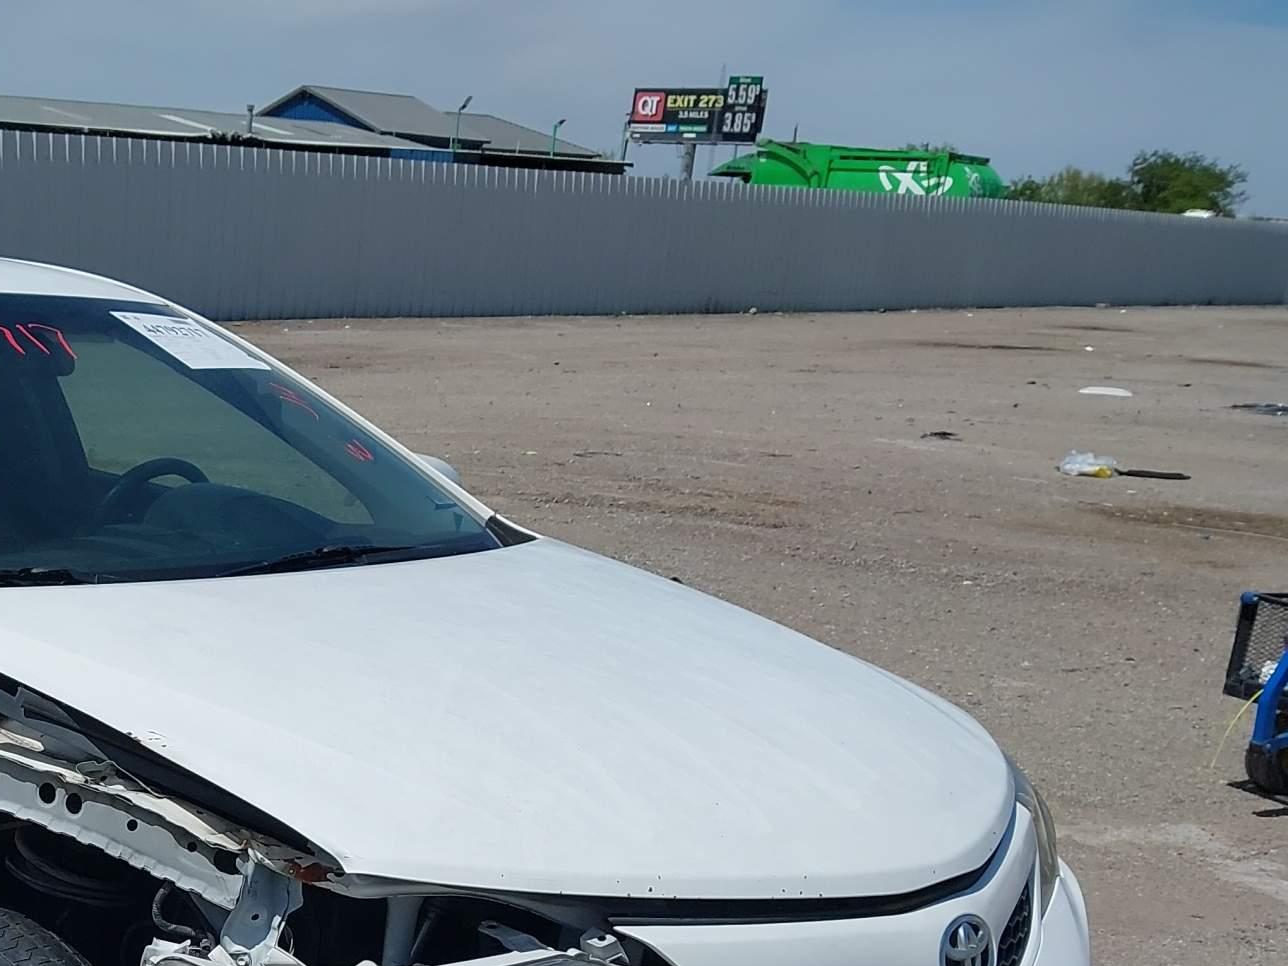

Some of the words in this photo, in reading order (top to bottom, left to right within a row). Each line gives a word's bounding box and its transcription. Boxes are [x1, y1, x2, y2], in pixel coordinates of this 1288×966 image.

[637, 95, 661, 117] QT
[667, 94, 697, 108] EXIT
[698, 94, 724, 108] 273
